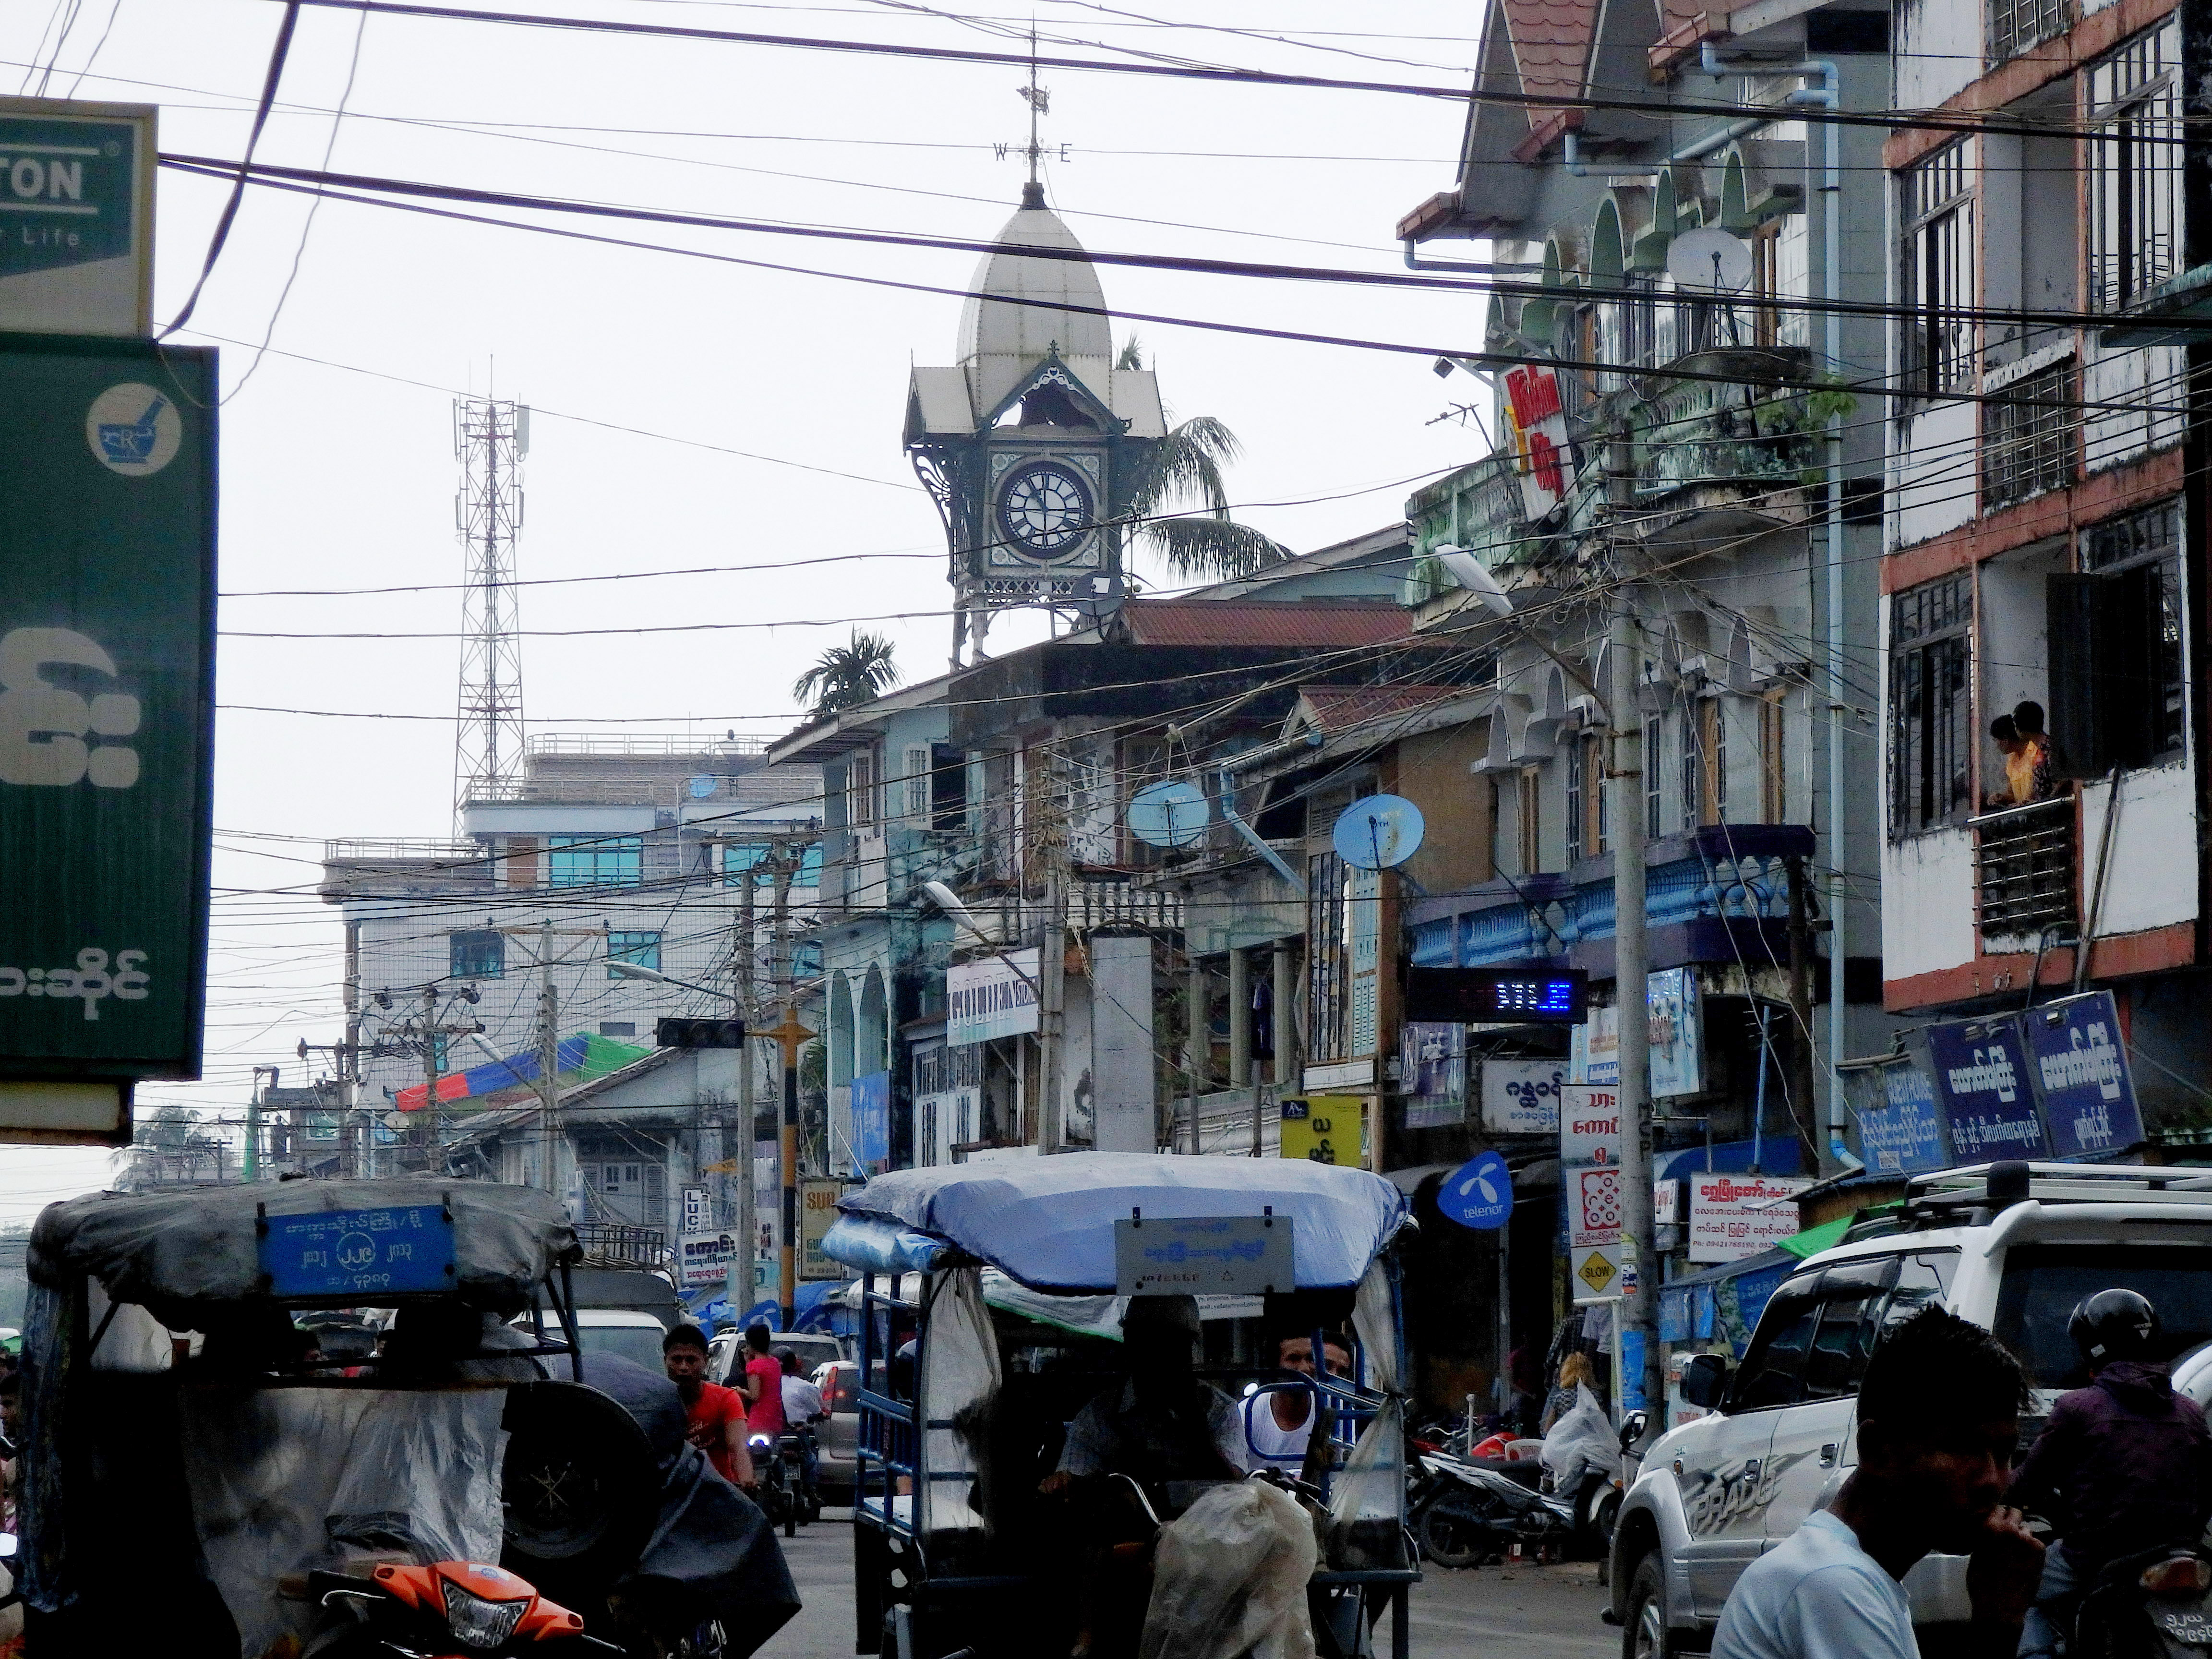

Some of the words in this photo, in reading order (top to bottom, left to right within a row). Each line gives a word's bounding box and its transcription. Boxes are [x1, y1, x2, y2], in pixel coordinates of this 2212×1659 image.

[0, 156, 82, 201] ON
[23, 228, 80, 246] Life
[949, 972, 1017, 1029] GOLDEN
[1463, 1203, 1504, 1219] telenor
[1585, 1266, 1610, 1278] SLOW
[1691, 1470, 1776, 1532] PRADO
